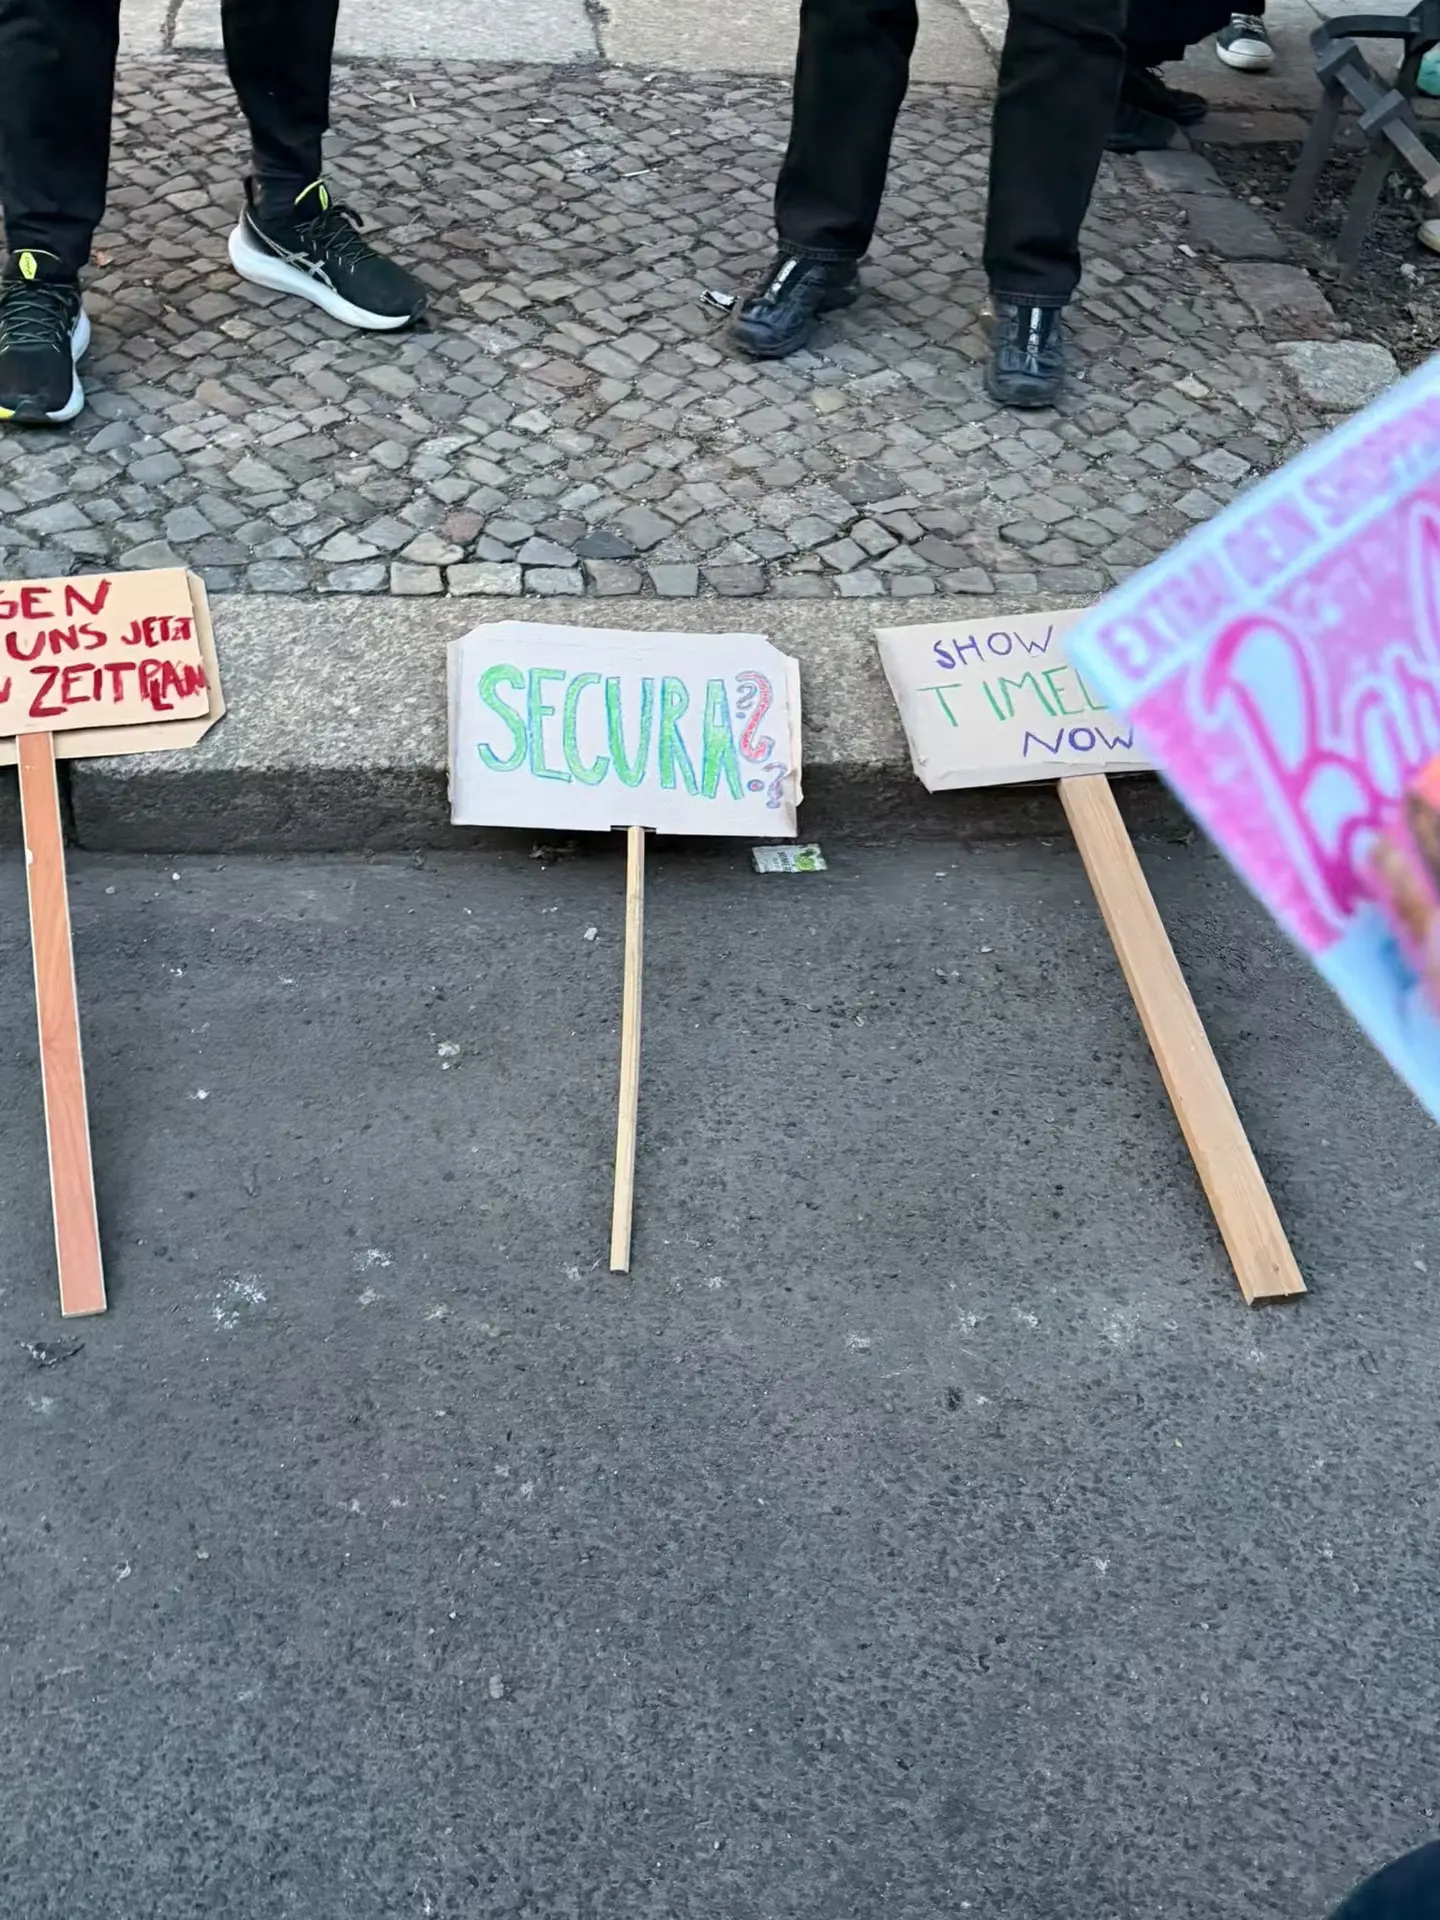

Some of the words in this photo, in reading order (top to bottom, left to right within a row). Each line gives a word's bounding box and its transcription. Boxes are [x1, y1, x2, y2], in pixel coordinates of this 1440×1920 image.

[5, 622, 107, 661] UNS
[933, 625, 1053, 669] SHOW
[1023, 723, 1134, 757] NOW
